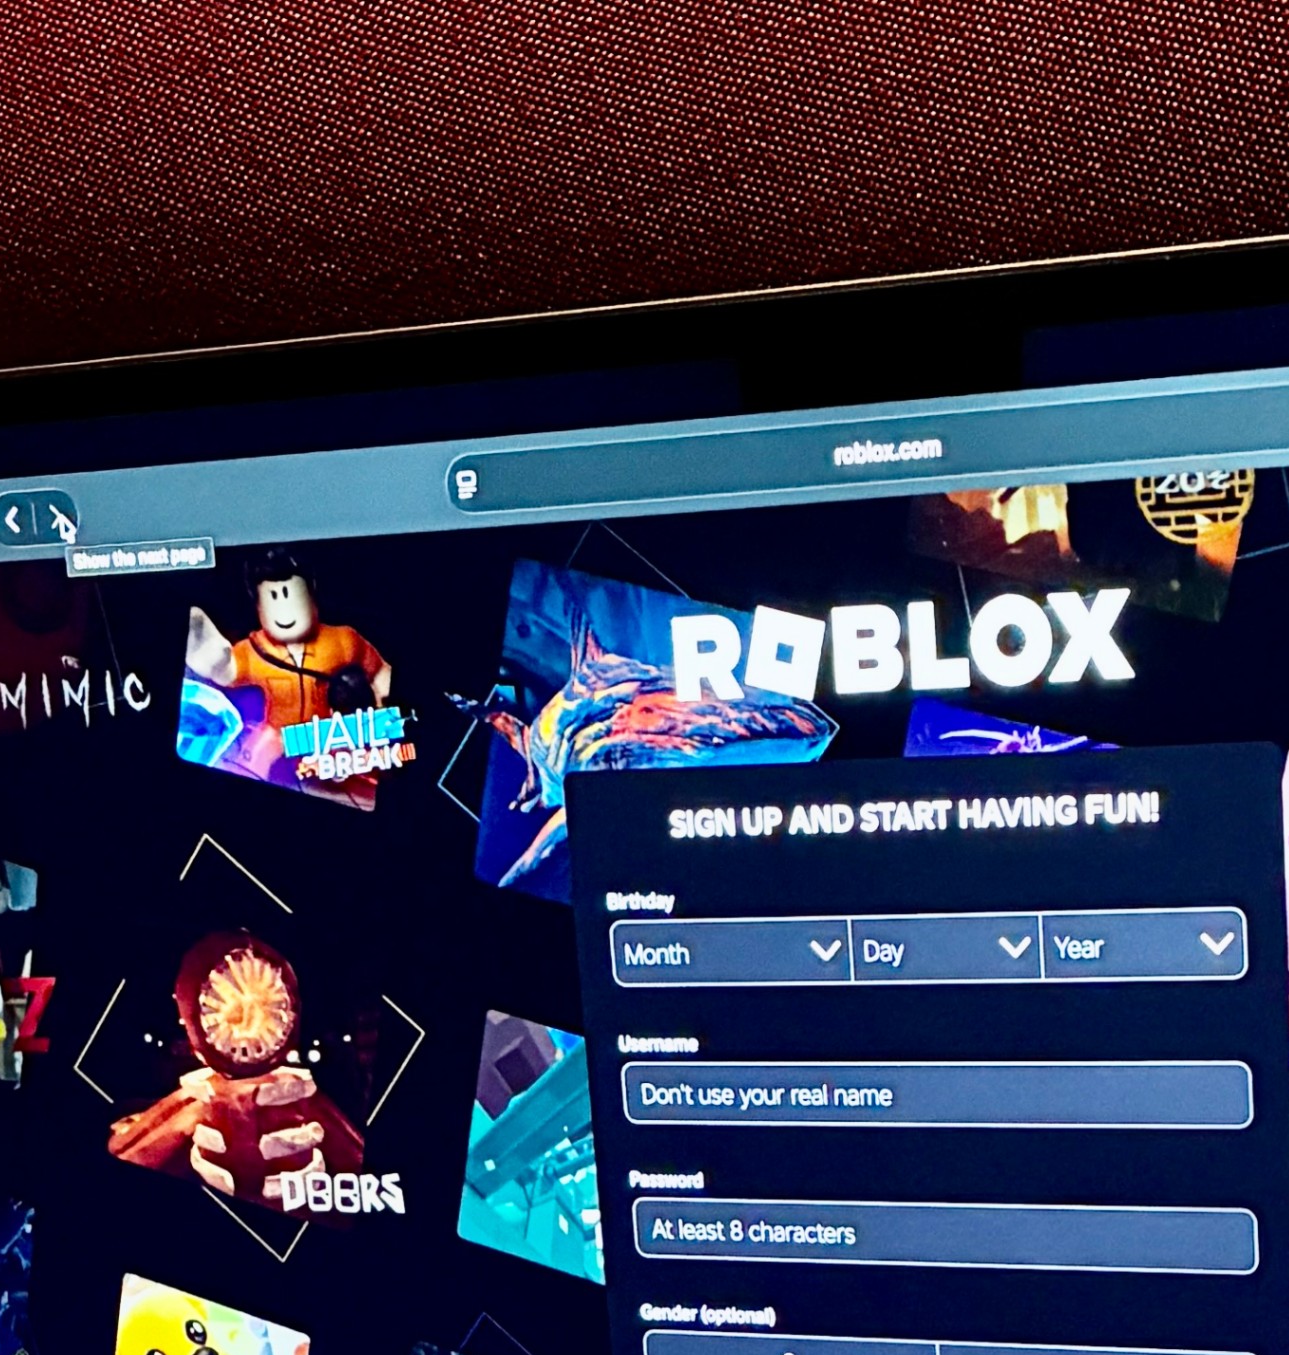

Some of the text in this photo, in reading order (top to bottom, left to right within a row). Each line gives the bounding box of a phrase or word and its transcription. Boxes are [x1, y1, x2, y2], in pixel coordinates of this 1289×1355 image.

[833, 438, 943, 466] roblox.com
[72, 552, 111, 570] Show
[112, 549, 137, 568] the
[170, 546, 206, 566] page
[670, 588, 1136, 702] ROBLOX
[302, 706, 390, 764] JAIL
[318, 743, 403, 780] BREAK
[668, 791, 1160, 839] SIGN UP AND START HAVING FUN!
[605, 891, 676, 914] Birthday
[624, 942, 690, 966] Month
[863, 939, 905, 968] Day
[1053, 935, 1105, 960] Year
[617, 1034, 700, 1054] Username
[640, 1082, 893, 1111] Don't use your real name
[628, 1169, 705, 1189] Password
[279, 1172, 406, 1214] DOORS
[652, 1218, 856, 1245] At least 8 characters
[639, 1302, 777, 1328] Gender (optional)
